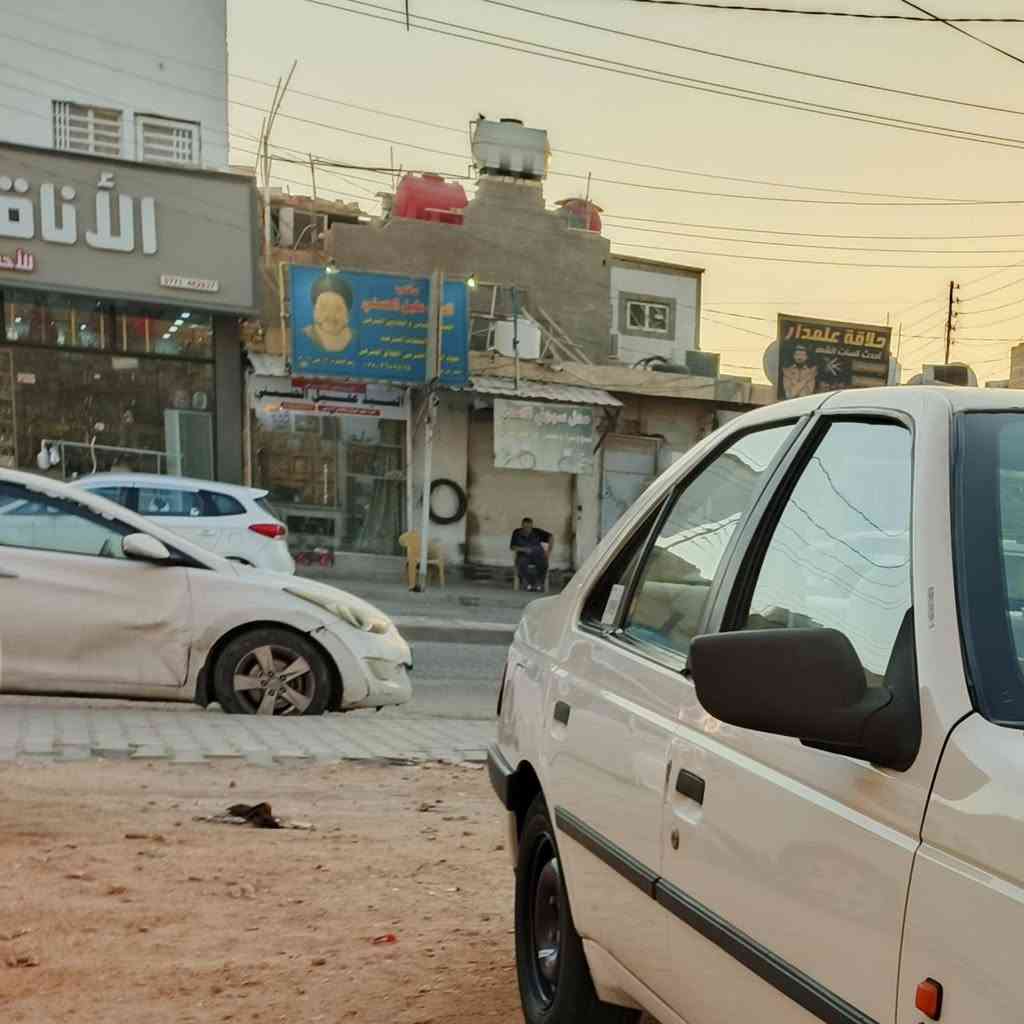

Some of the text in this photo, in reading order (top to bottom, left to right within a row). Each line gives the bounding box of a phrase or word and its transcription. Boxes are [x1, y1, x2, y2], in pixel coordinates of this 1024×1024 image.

[0, 172, 157, 254] الأناق
[785, 322, 887, 349] حلاقة علمدار
